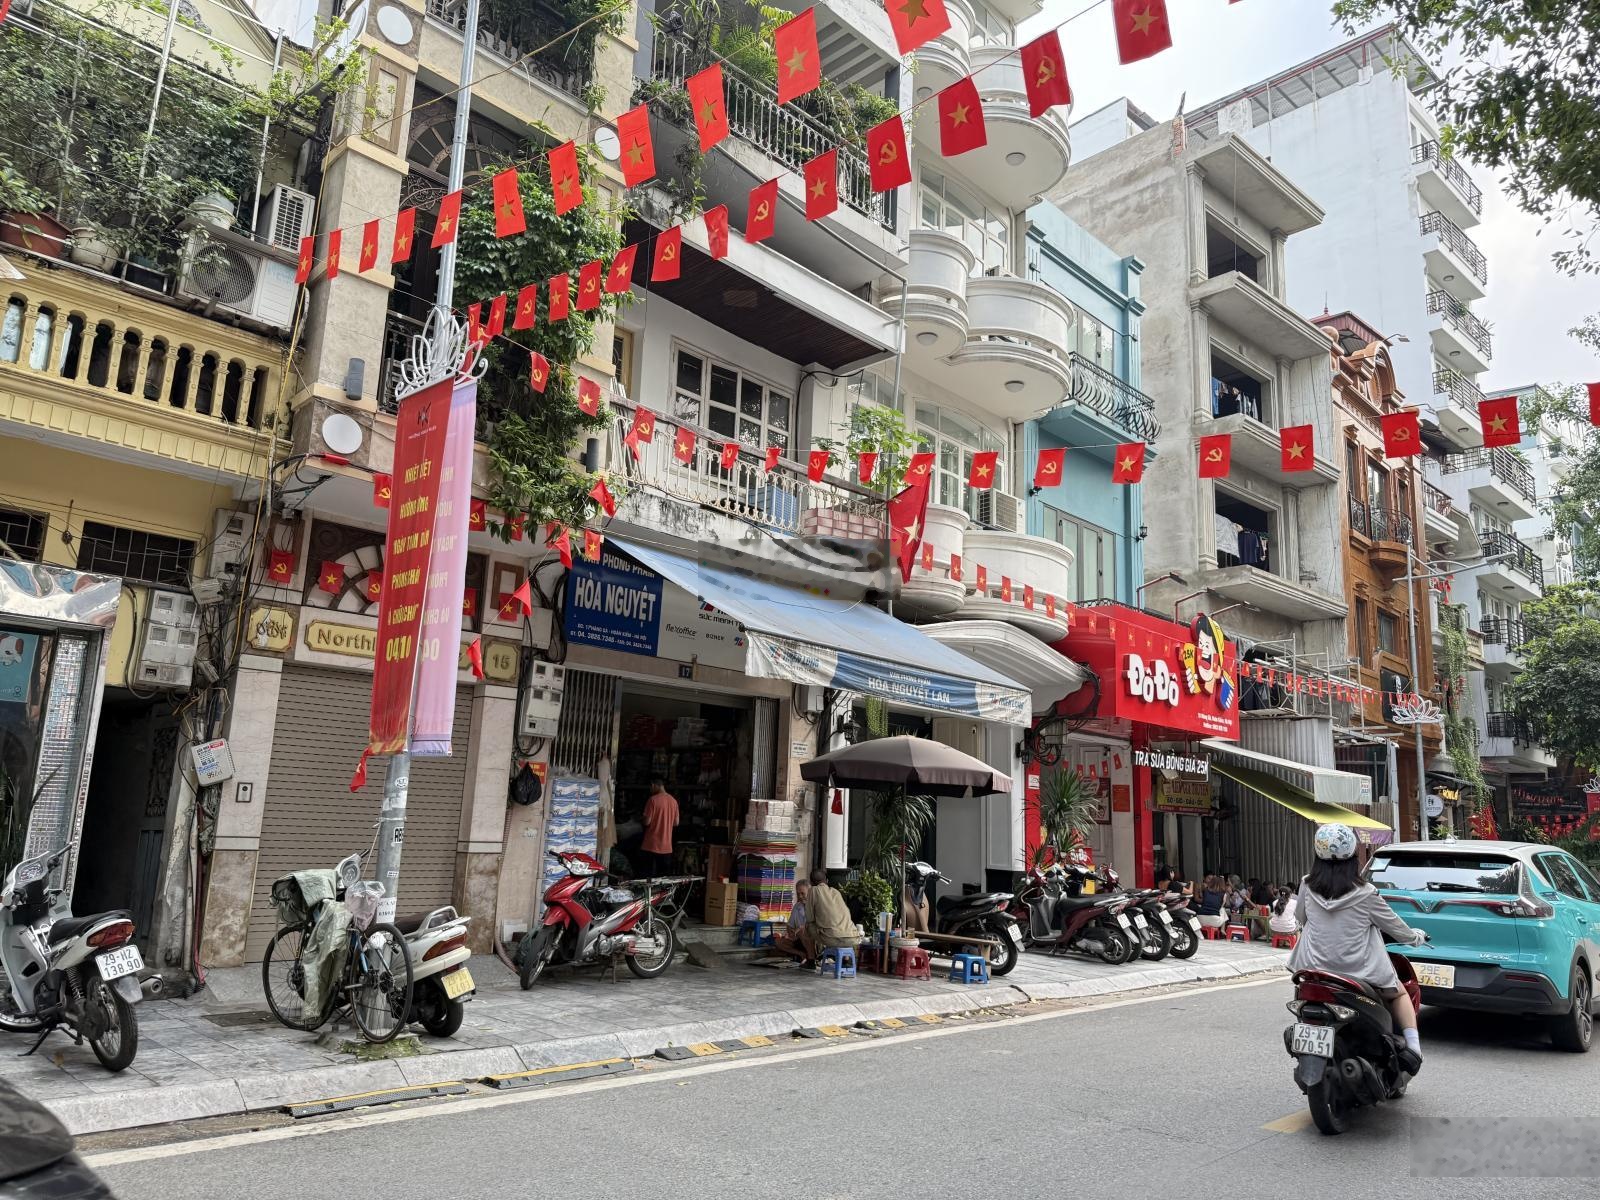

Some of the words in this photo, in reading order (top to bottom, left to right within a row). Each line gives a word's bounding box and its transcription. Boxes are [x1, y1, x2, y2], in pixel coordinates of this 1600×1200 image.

[574, 571, 601, 612] HÒA
[604, 584, 657, 628] NGUYỆT
[492, 654, 510, 670] 15
[1184, 649, 1194, 660] 25K
[868, 676, 888, 691] HÒA
[892, 682, 928, 701] NGUYỆT
[1135, 748, 1149, 767] TRÀ
[1150, 749, 1165, 769] SỮA
[1166, 748, 1184, 772] ĐỒNG
[1184, 755, 1196, 774] GIÁ
[103, 958, 141, 978] 138.90
[1419, 964, 1441, 975] 29E
[1298, 1025, 1329, 1041] 29-X7
[1294, 1038, 1331, 1056] 070.51
